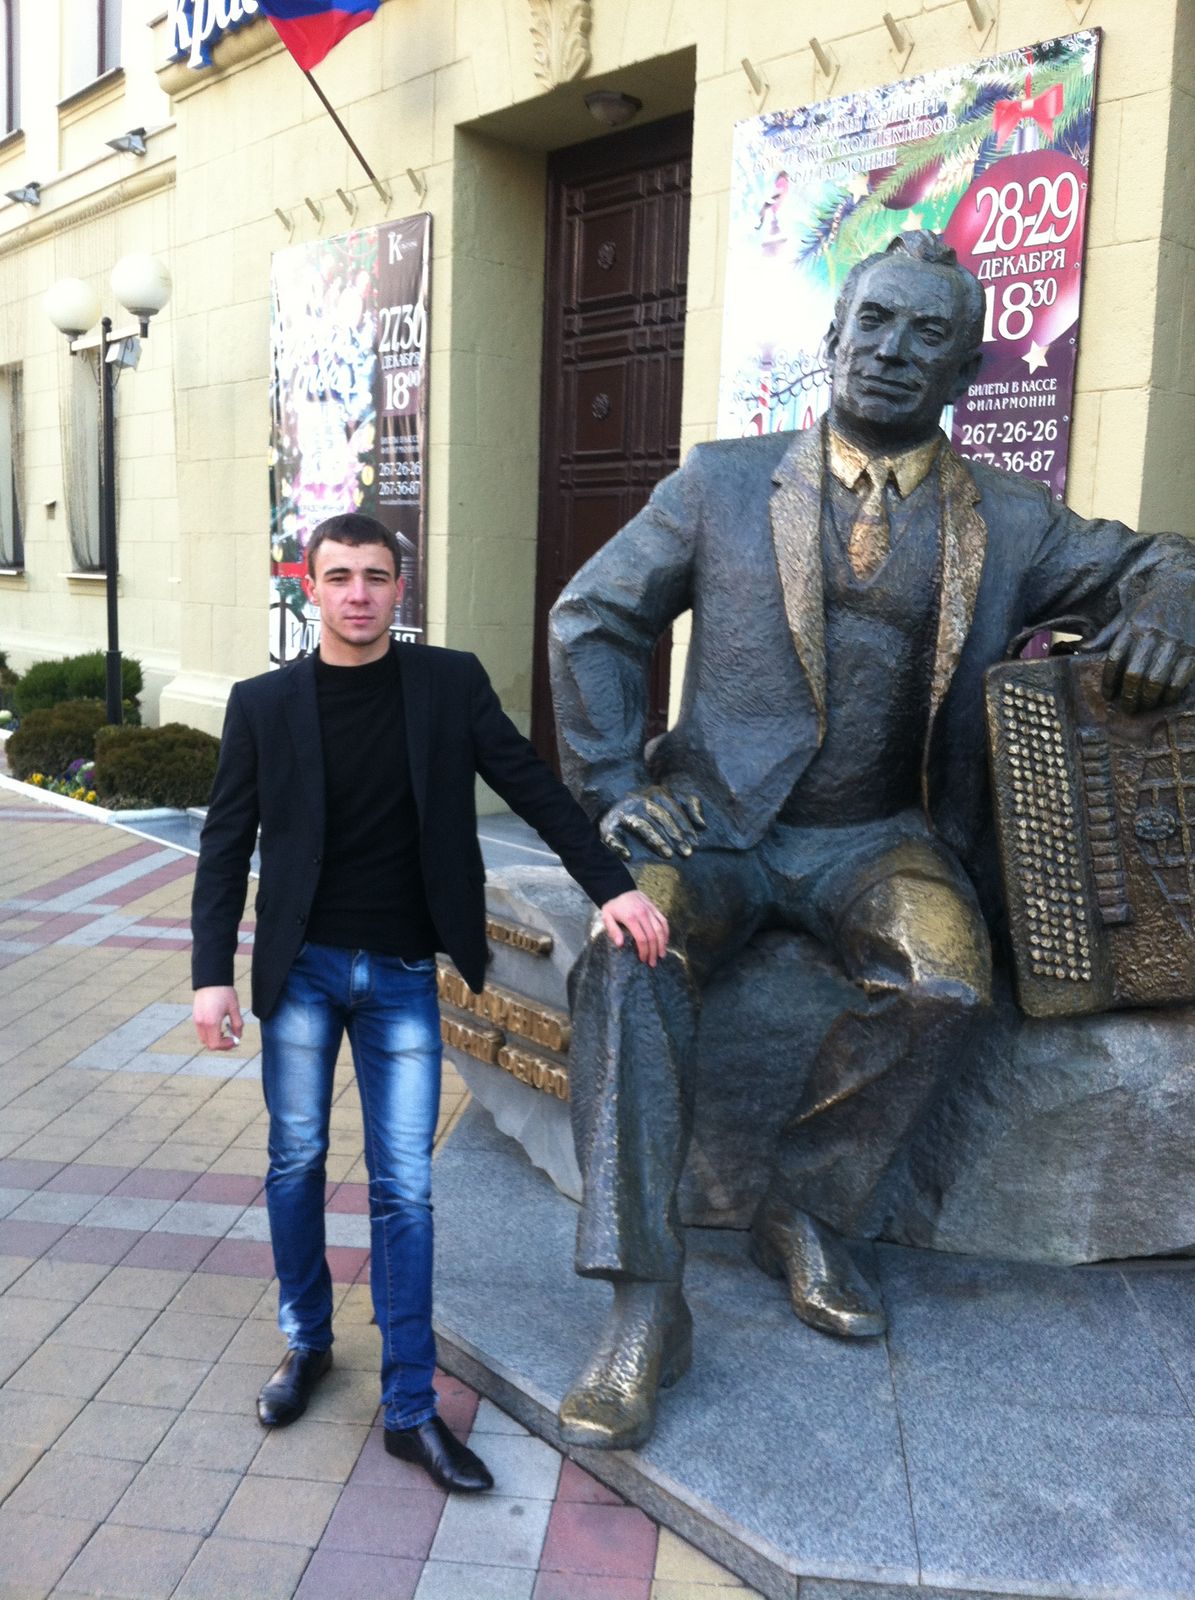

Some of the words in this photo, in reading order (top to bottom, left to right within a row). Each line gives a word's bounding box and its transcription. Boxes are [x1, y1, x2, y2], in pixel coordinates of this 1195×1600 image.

[971, 171, 1080, 255] 28-29
[977, 248, 1066, 281] ДЕКАБРЯ
[967, 382, 1009, 397] БИЛЕТЫ
[1011, 381, 1020, 394] В
[1021, 378, 1057, 392] КАССЕ
[966, 394, 1056, 412] ФИЛАРМОНИИ
[961, 419, 1058, 446] 267-26-26
[378, 462, 421, 477] 267-26-26
[378, 480, 421, 496] 267-36-87
